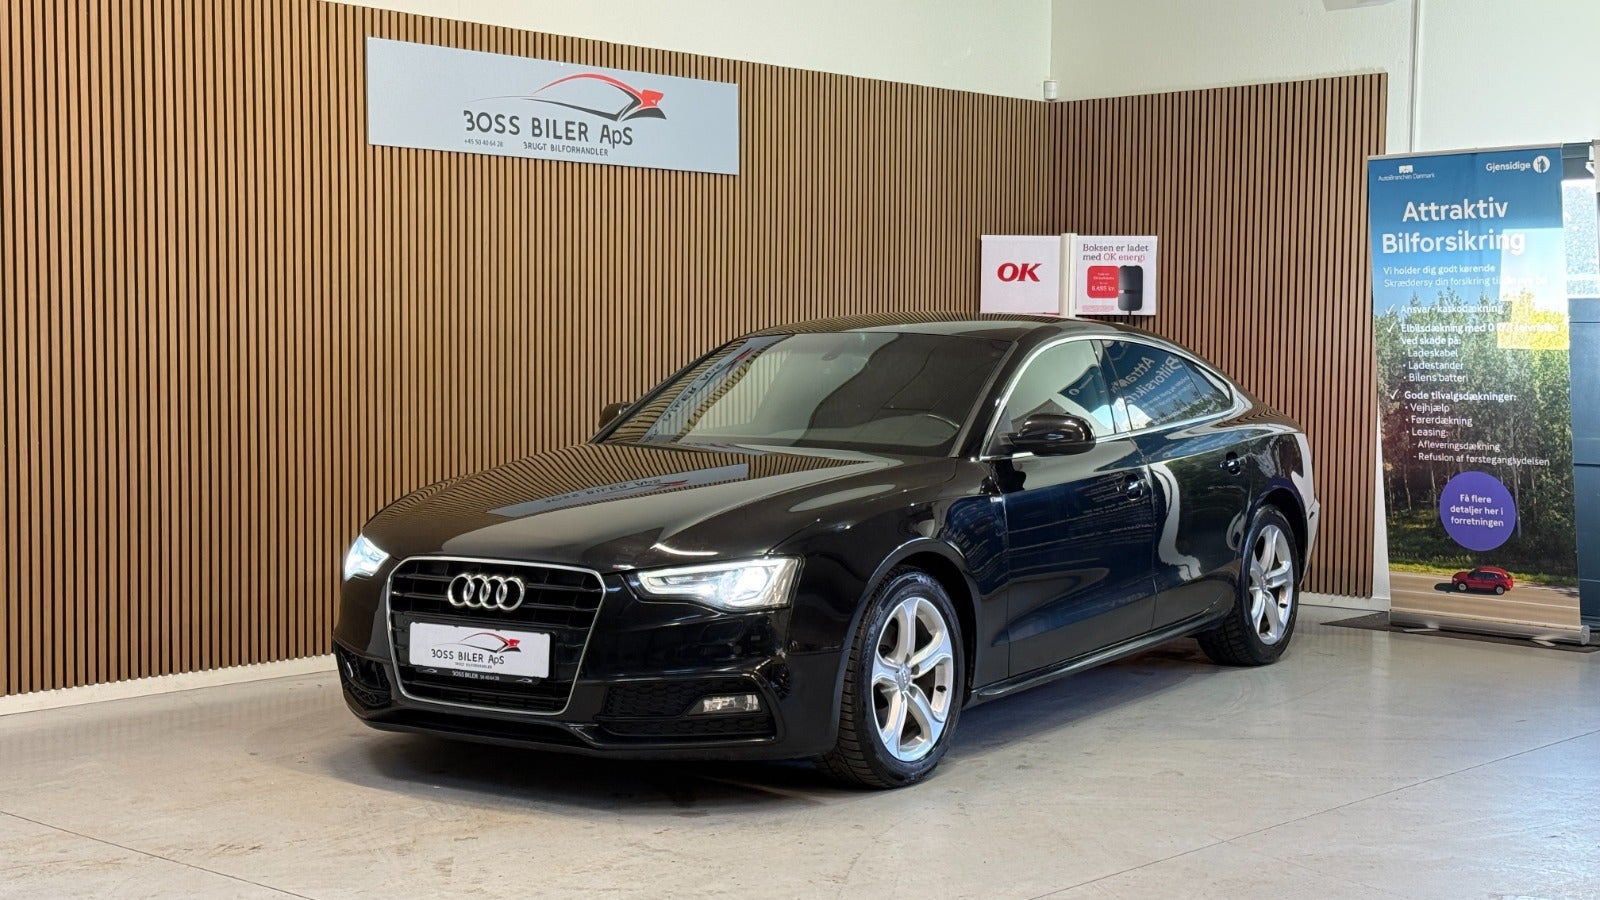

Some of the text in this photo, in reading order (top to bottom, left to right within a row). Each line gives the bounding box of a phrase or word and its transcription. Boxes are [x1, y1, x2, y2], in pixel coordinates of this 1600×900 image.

[532, 117, 588, 142] BILER
[600, 124, 633, 149] ApS
[550, 144, 608, 156] BILFORHANDLER
[1486, 161, 1531, 172] Gjensidige
[1402, 197, 1508, 222] Attraktiv
[1083, 243, 1114, 252] Boksen
[1382, 229, 1526, 255] Bilforsikring
[1119, 254, 1145, 263] energi
[997, 262, 1042, 282] OK
[1394, 266, 1420, 274] holder
[1422, 265, 1436, 275] dig
[1438, 265, 1458, 275] godt
[1459, 264, 1496, 273] kørende
[1384, 279, 1432, 287] Skræddersy
[1450, 277, 1490, 287] forsikring
[1438, 304, 1504, 314] kaskodækning
[1401, 324, 1464, 334] Elbilsdækning
[1465, 323, 1486, 332] med
[1401, 336, 1418, 344] ved
[1420, 336, 1446, 344] skade
[1408, 349, 1458, 358] Ladeskabel
[1409, 361, 1464, 370] Ladestander
[1409, 372, 1468, 382] Bilens batteri
[1404, 391, 1517, 403] Gode tilvalgsdækninger:
[1410, 403, 1450, 413] Vejhjælp
[1411, 415, 1473, 427] Førerdækning
[1418, 441, 1500, 452] Afleveringsdækning
[1419, 453, 1454, 462] Refusion
[1460, 494, 1492, 503] Få flere
[1450, 505, 1483, 516] detaljer
[1500, 507, 1504, 515] i
[1451, 516, 1504, 528] forretningen
[458, 652, 484, 662] BILER
[488, 655, 504, 665] ApS
